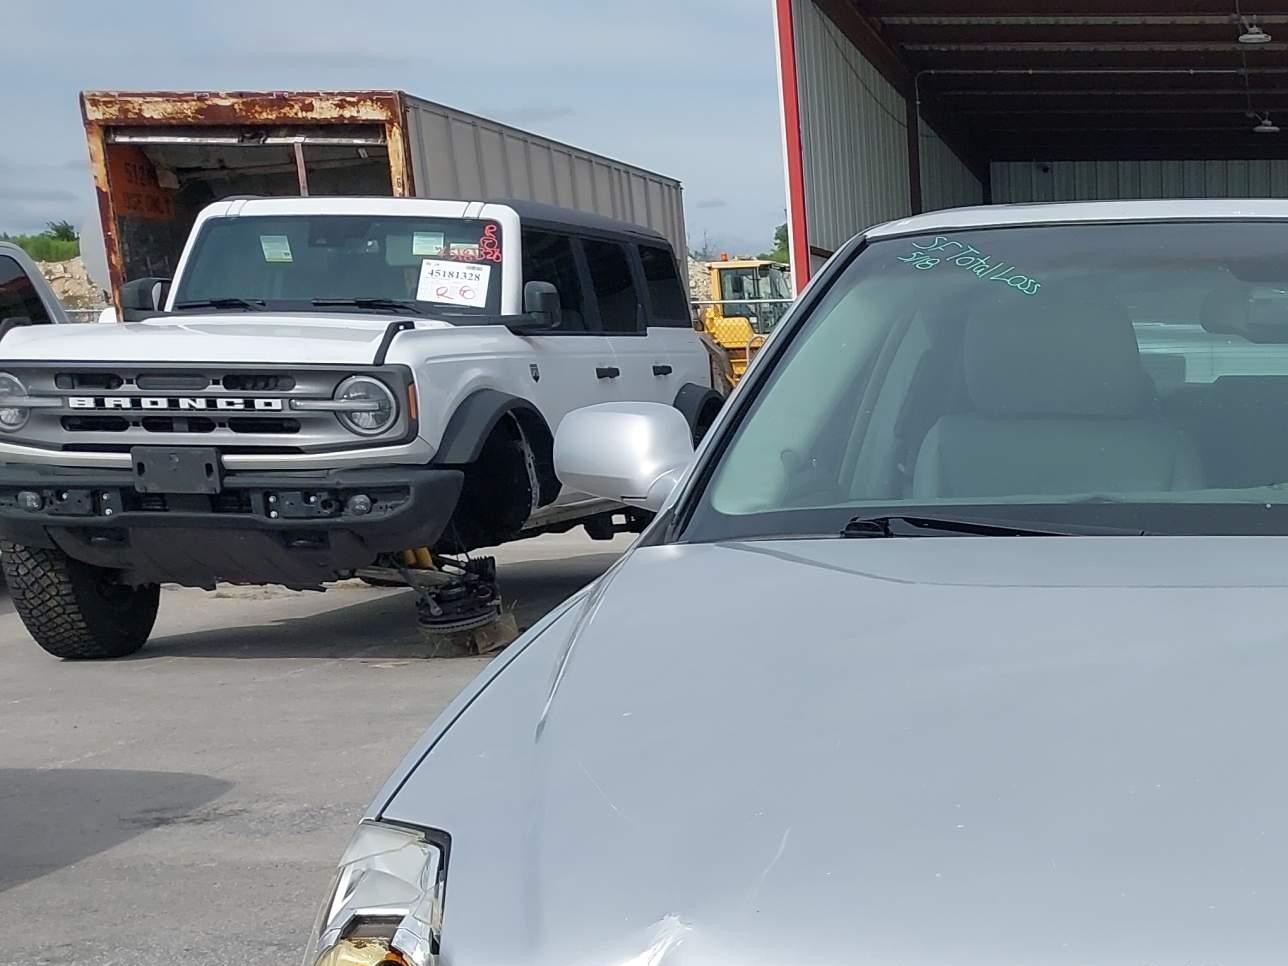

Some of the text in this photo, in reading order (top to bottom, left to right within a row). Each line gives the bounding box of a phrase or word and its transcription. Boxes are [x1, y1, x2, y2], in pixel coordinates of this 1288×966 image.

[427, 268, 481, 282] 45181328
[946, 245, 1003, 279] Total
[990, 266, 1041, 295] Loss
[69, 397, 283, 410] BRONCO
